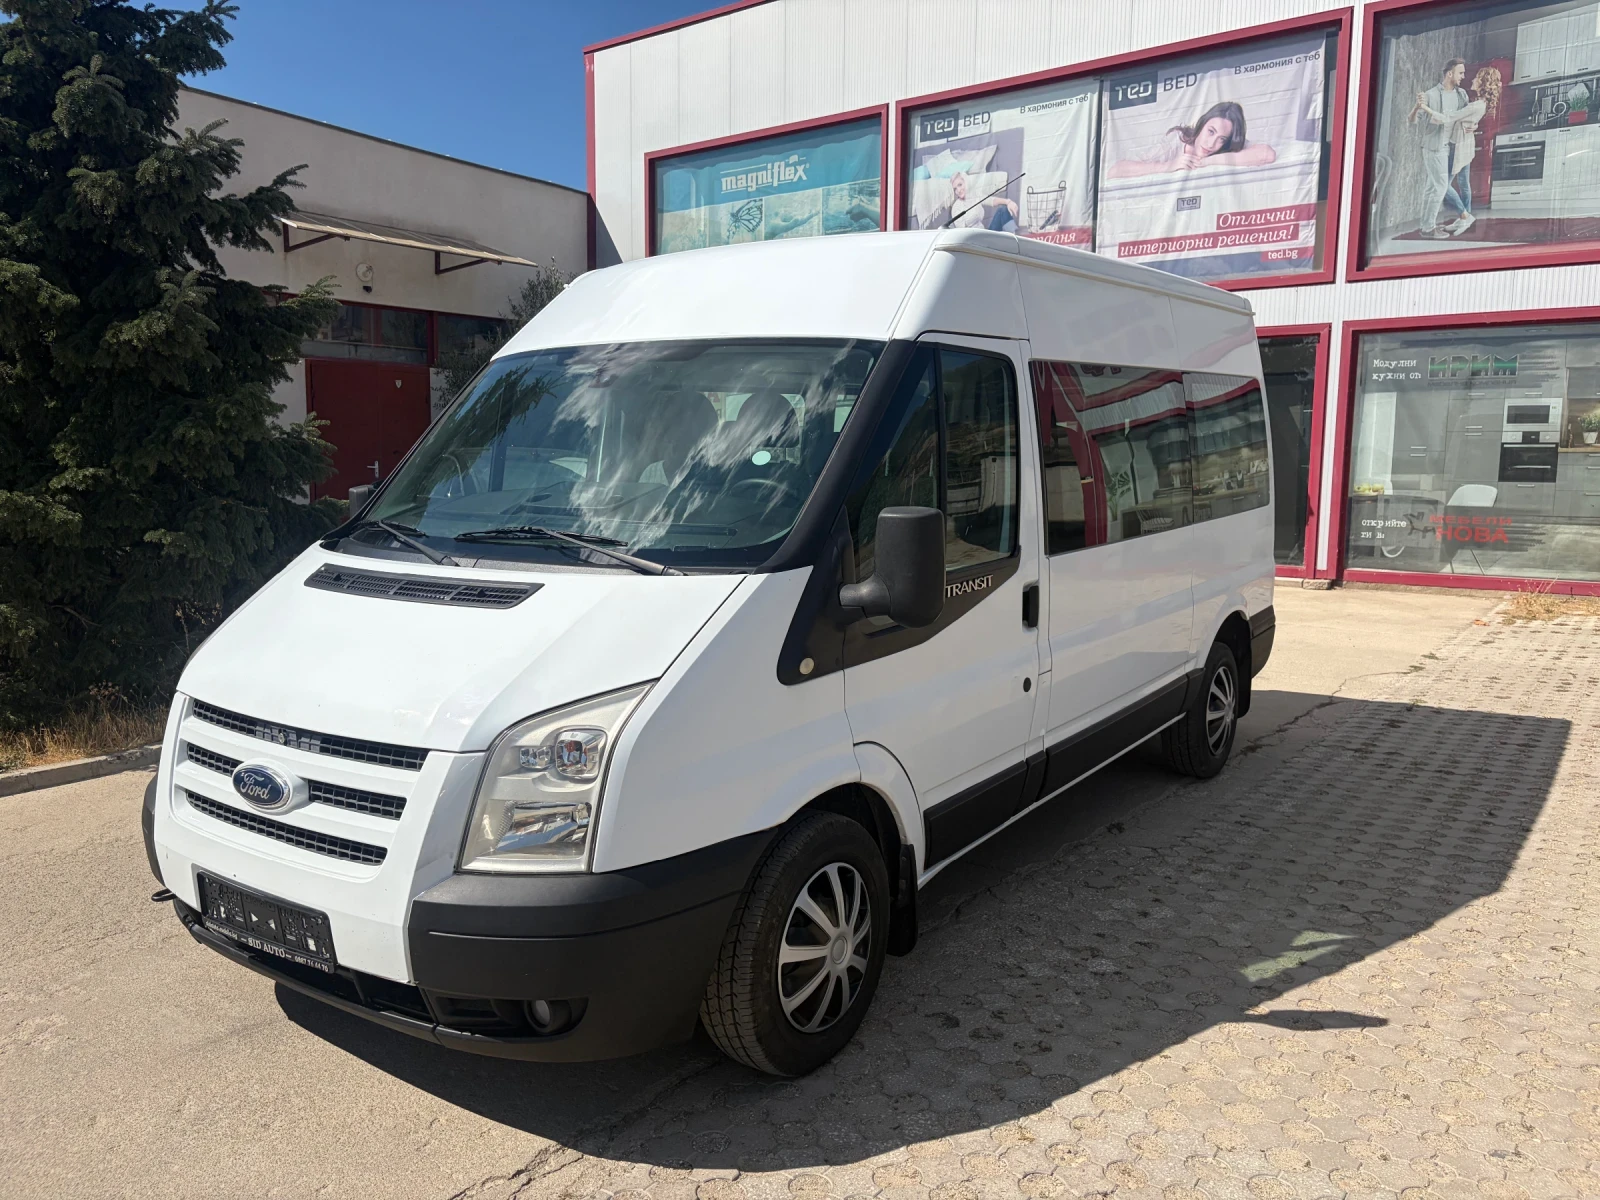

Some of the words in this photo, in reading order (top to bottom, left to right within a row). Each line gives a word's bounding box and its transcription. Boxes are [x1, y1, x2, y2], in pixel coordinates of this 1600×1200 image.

[1234, 65, 1242, 75] В
[1243, 57, 1293, 74] хармония
[1295, 56, 1302, 64] с
[1303, 51, 1321, 63] теб
[1163, 72, 1198, 92] BED
[1019, 105, 1027, 115] В
[1028, 100, 1067, 114] хармония
[1075, 94, 1089, 104] теб
[963, 111, 991, 128] BED
[720, 161, 808, 192] magniflex
[1219, 208, 1296, 228] Отлични
[1119, 237, 1214, 257] интериорни
[1217, 225, 1294, 250] решения!
[1267, 249, 1299, 262] ted.bg
[1372, 358, 1417, 368] Модулни
[1428, 354, 1520, 379] ИРИМ
[1371, 371, 1406, 382] кухни
[1429, 515, 1513, 526] МЕБЕЛИ
[1435, 525, 1510, 544] НОВА
[945, 574, 994, 598] TRANSIT
[240, 772, 272, 800] Ford
[263, 943, 286, 957] AUTO
